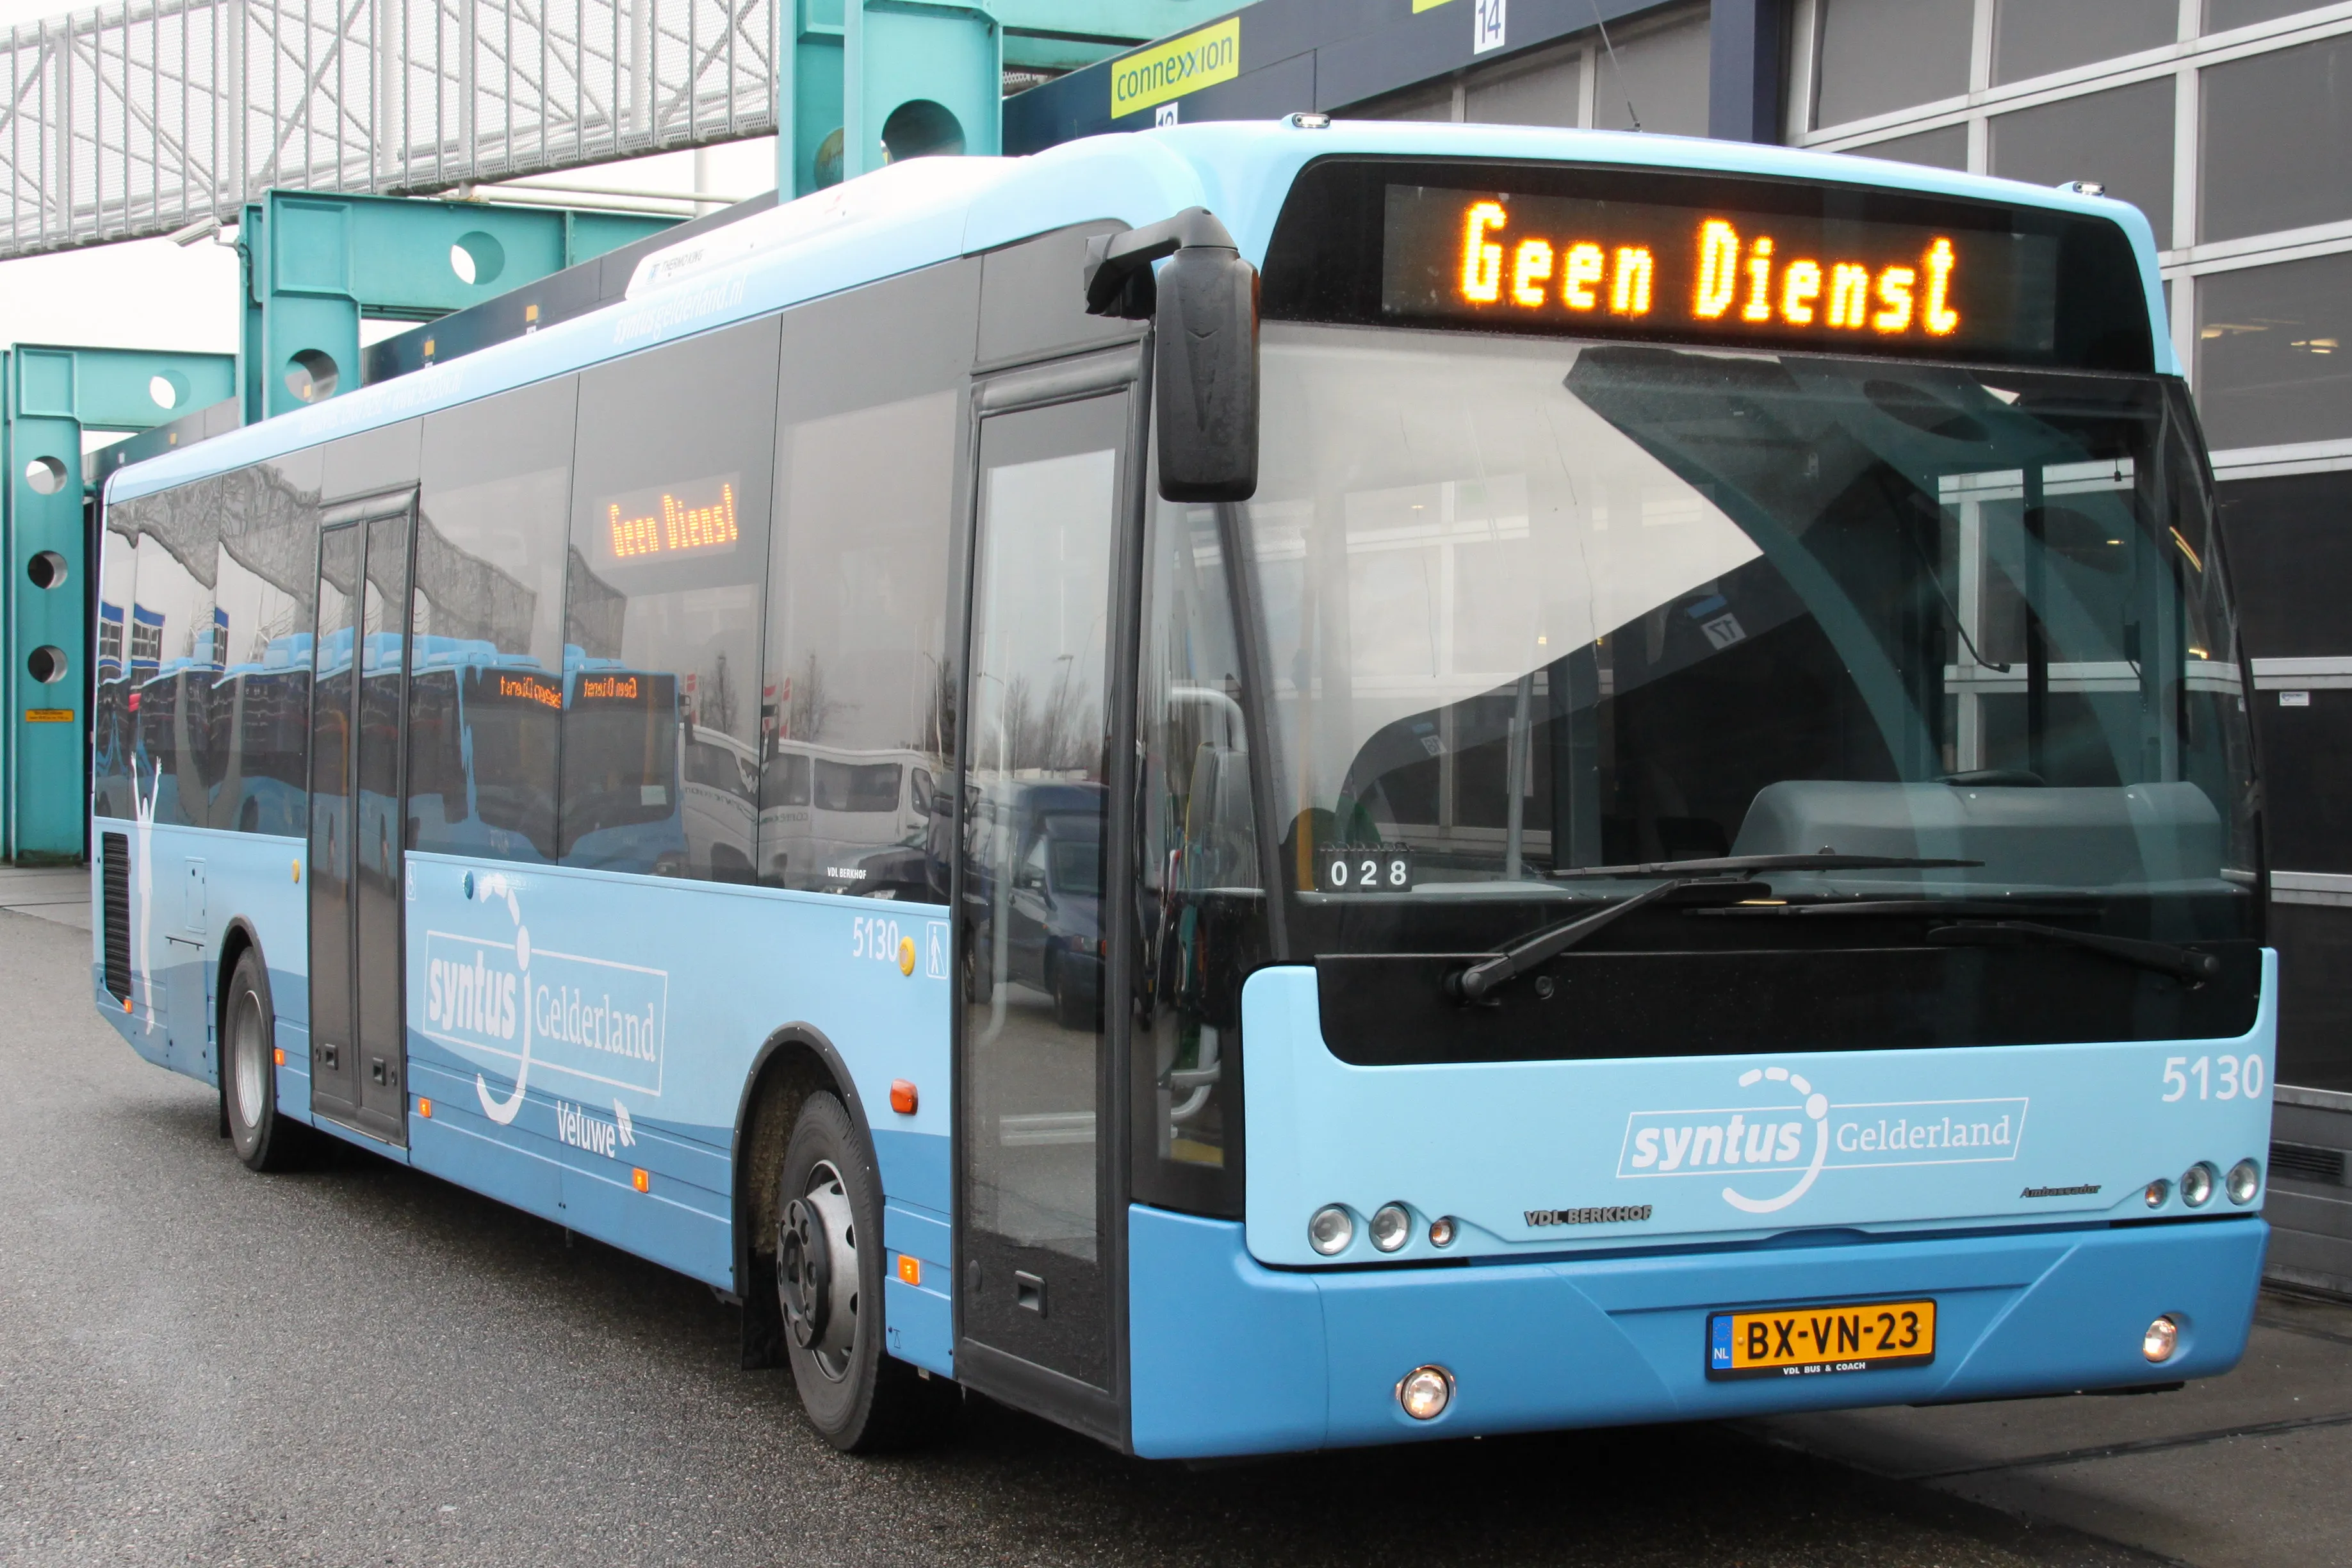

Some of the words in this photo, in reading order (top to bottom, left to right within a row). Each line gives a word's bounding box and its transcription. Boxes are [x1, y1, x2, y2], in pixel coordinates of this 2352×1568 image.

[1478, 0, 1501, 44] 14
[1117, 35, 1233, 101] connexxion
[1460, 200, 1654, 315] Geen
[1692, 216, 1960, 336] Dienst
[827, 867, 838, 877] VDL
[839, 868, 867, 879] BERKHOF
[853, 917, 899, 962] 5130
[429, 949, 516, 1040] syntus
[535, 984, 656, 1063] Gelderland
[2162, 1054, 2264, 1102] 5130
[557, 1100, 616, 1158] Veluwe
[1631, 1114, 1802, 1171] syntus
[1836, 1115, 2011, 1152] Gelderland
[2019, 1184, 2102, 1198] Ambassador
[1524, 1209, 1563, 1227] VDL
[1567, 1204, 1653, 1225] BERKHOF
[1713, 1347, 1729, 1360] NL
[1747, 1311, 1919, 1360] BX-VN-23
[1783, 1366, 1801, 1375] VDL
[1804, 1364, 1821, 1374] BUS
[1836, 1361, 1866, 1371] COACH
